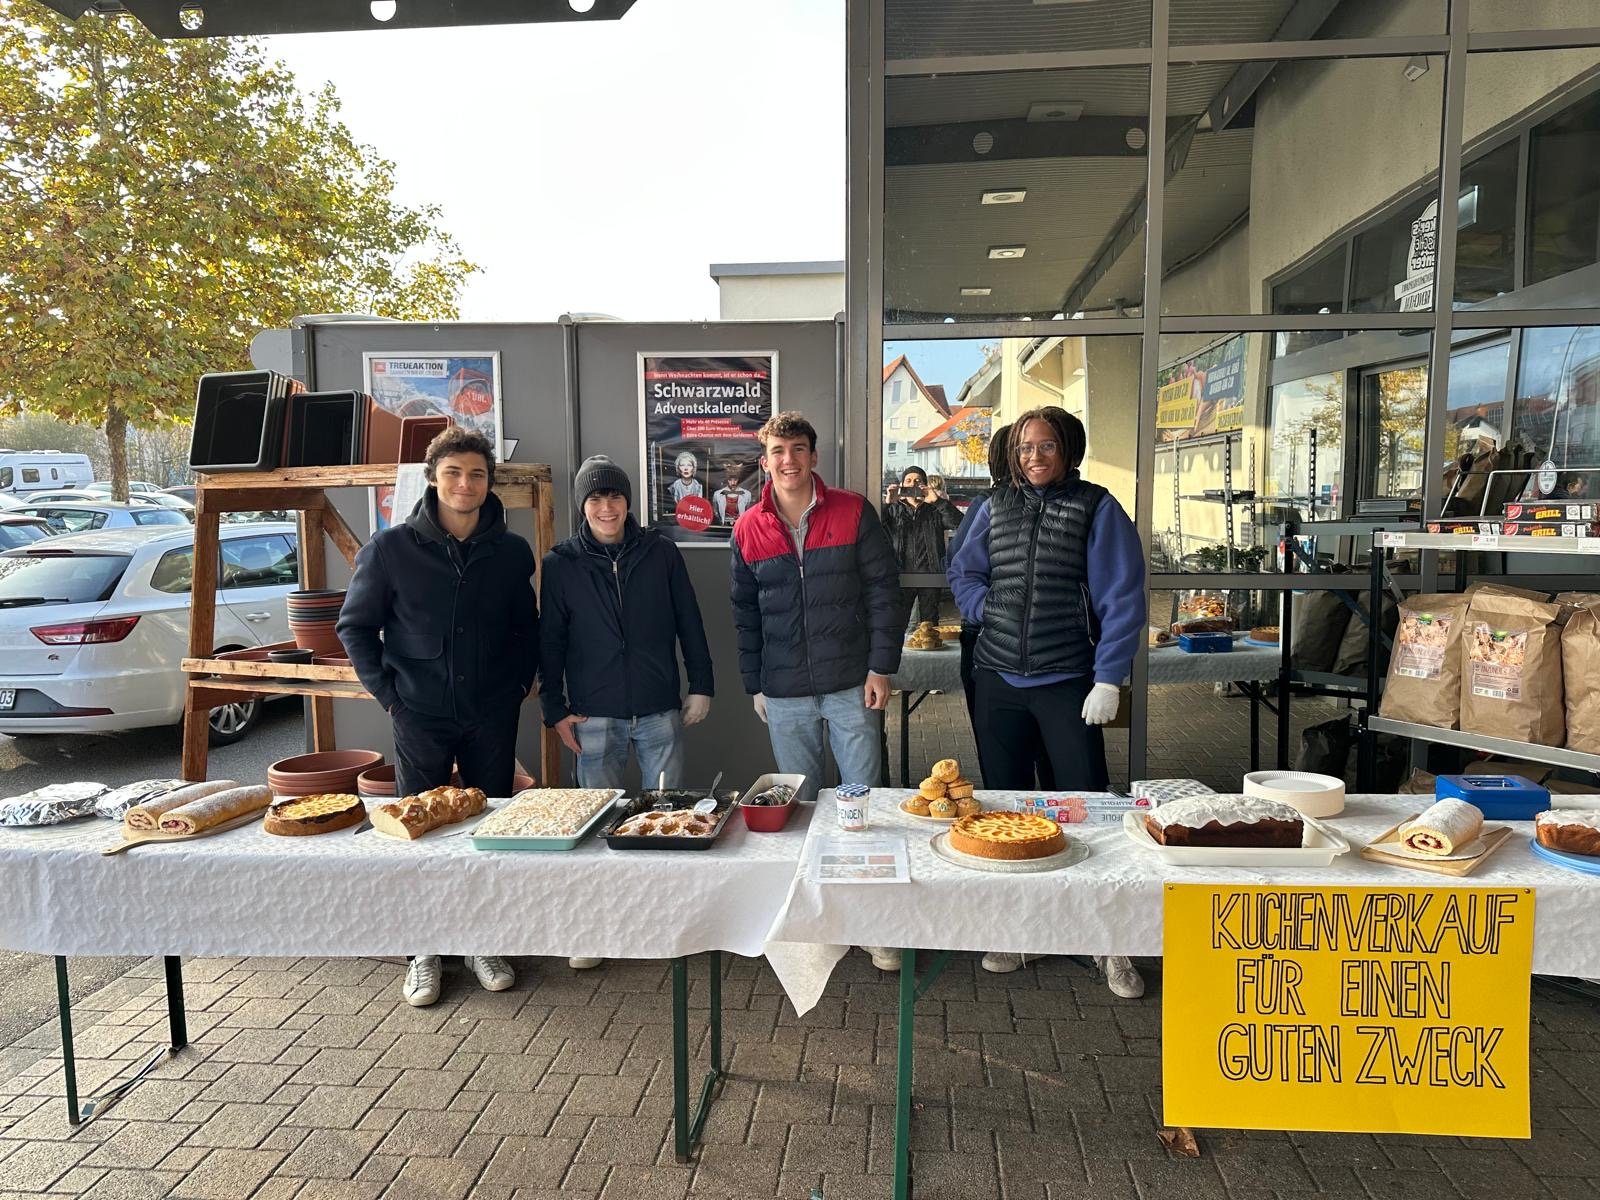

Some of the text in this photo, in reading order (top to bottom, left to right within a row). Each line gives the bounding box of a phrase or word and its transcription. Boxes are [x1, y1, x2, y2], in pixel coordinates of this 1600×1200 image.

[389, 361, 444, 371] TREUEAKTION
[668, 371, 703, 379] Weihnachten
[737, 371, 752, 379] schon
[654, 382, 761, 398] Schwarzwald
[654, 402, 762, 414] Adventskalender
[689, 504, 704, 513] Hier
[1535, 509, 1561, 519] GRILL
[677, 512, 711, 524] erhältlich!
[1453, 526, 1476, 534] GRILL
[1531, 528, 1557, 537] GRILL
[1212, 892, 1518, 954] KUCHENVERKAUF
[1236, 953, 1451, 1019] FÜR EINEN
[1217, 1023, 1506, 1089] GUTEN ZWECK
